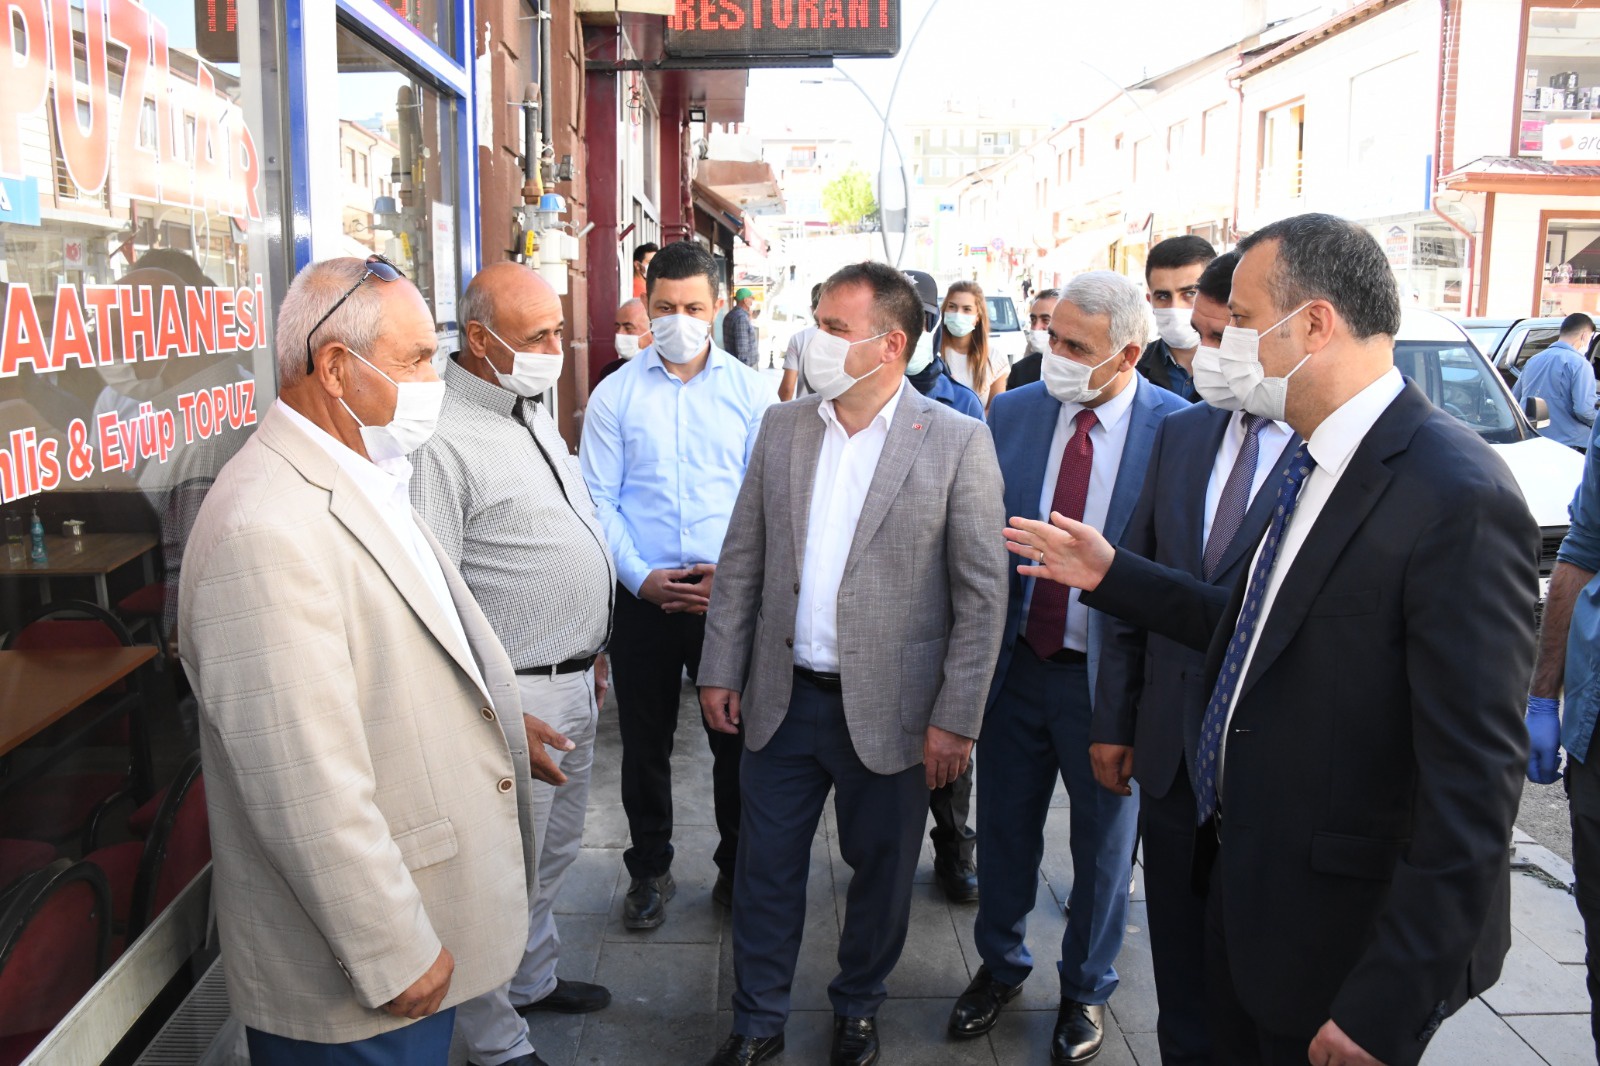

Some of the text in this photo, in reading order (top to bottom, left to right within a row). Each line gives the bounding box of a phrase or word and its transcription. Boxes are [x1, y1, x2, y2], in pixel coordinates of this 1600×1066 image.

[0, 273, 267, 378] AATHANESİ
[68, 418, 94, 480] &
[97, 402, 175, 472] Eyüp
[178, 380, 257, 444] TOPUZ
